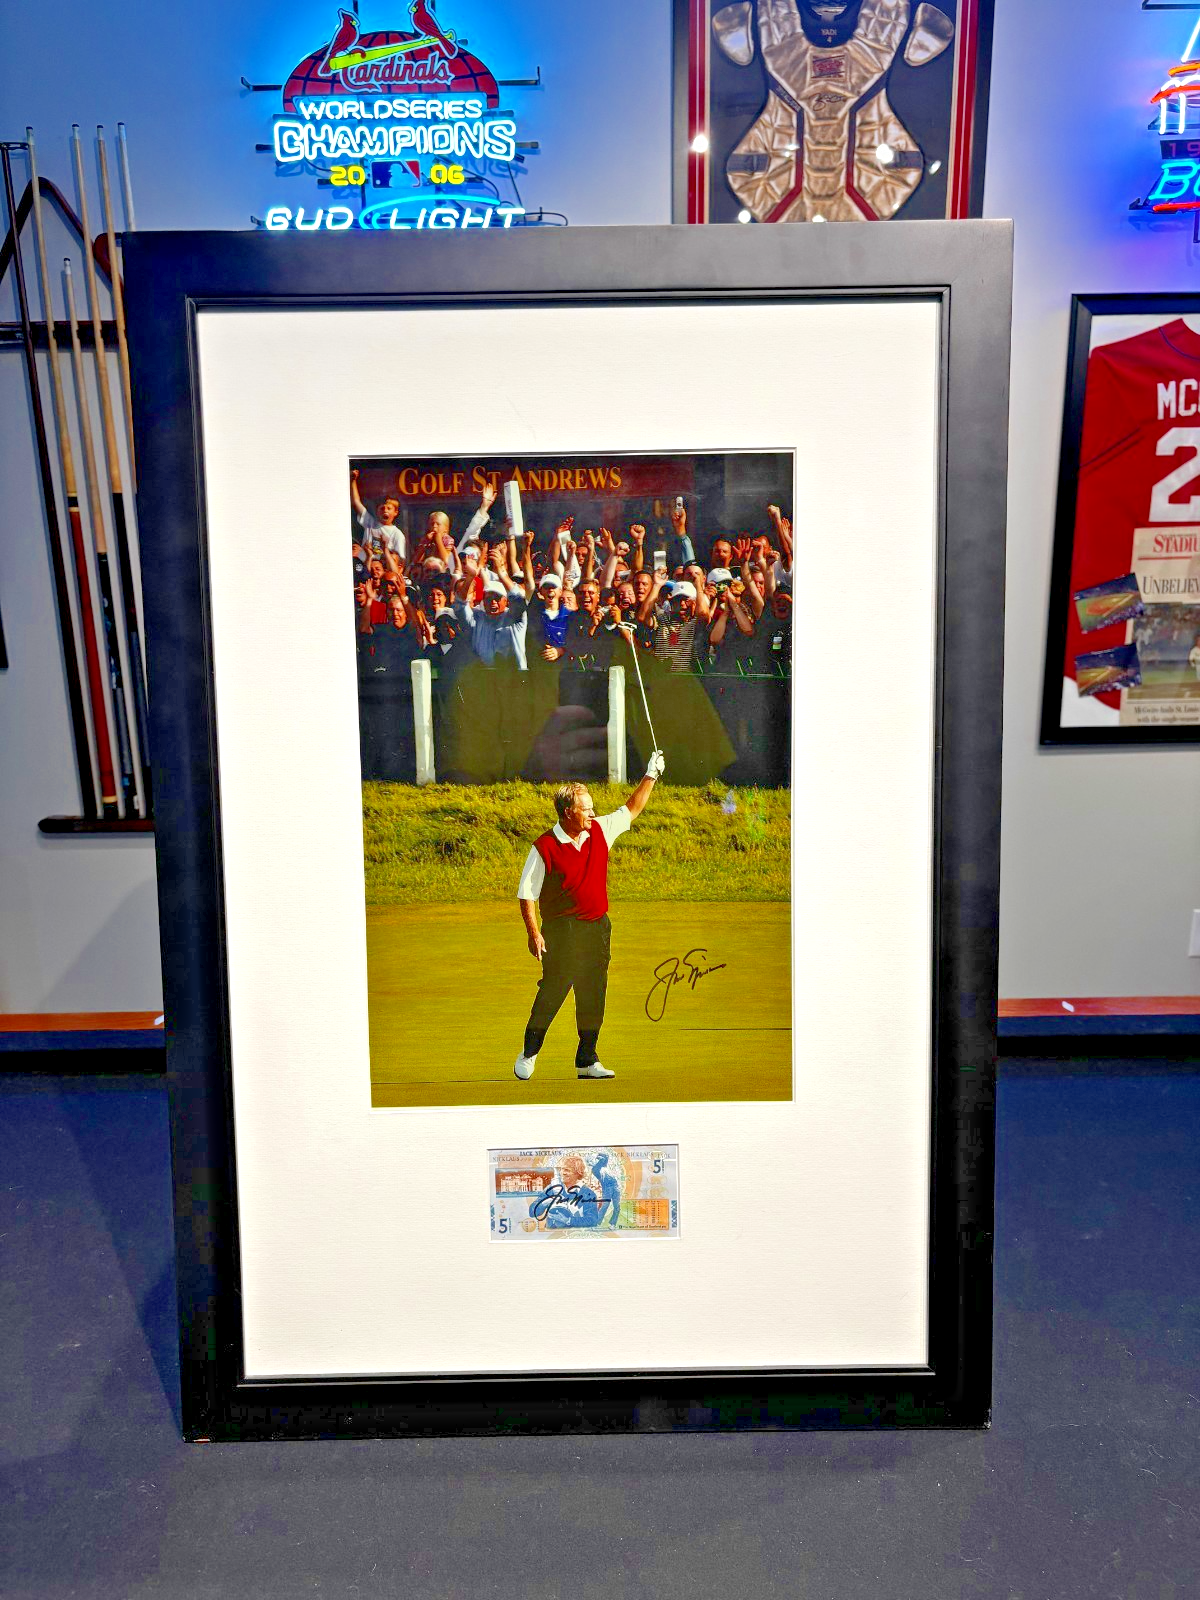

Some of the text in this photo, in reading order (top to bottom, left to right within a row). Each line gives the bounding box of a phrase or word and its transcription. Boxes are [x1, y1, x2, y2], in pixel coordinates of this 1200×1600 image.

[340, 52, 454, 92] Cardinals
[273, 119, 517, 163] CHAMPIONS
[330, 165, 366, 186] 20
[1148, 161, 1200, 200] B
[265, 207, 526, 230] BUD LIGHT
[1157, 378, 1200, 420] MC
[399, 464, 623, 495] GOLF ST ANDREWS
[652, 1159, 662, 1174] 5
[498, 1218, 508, 1233] 5
